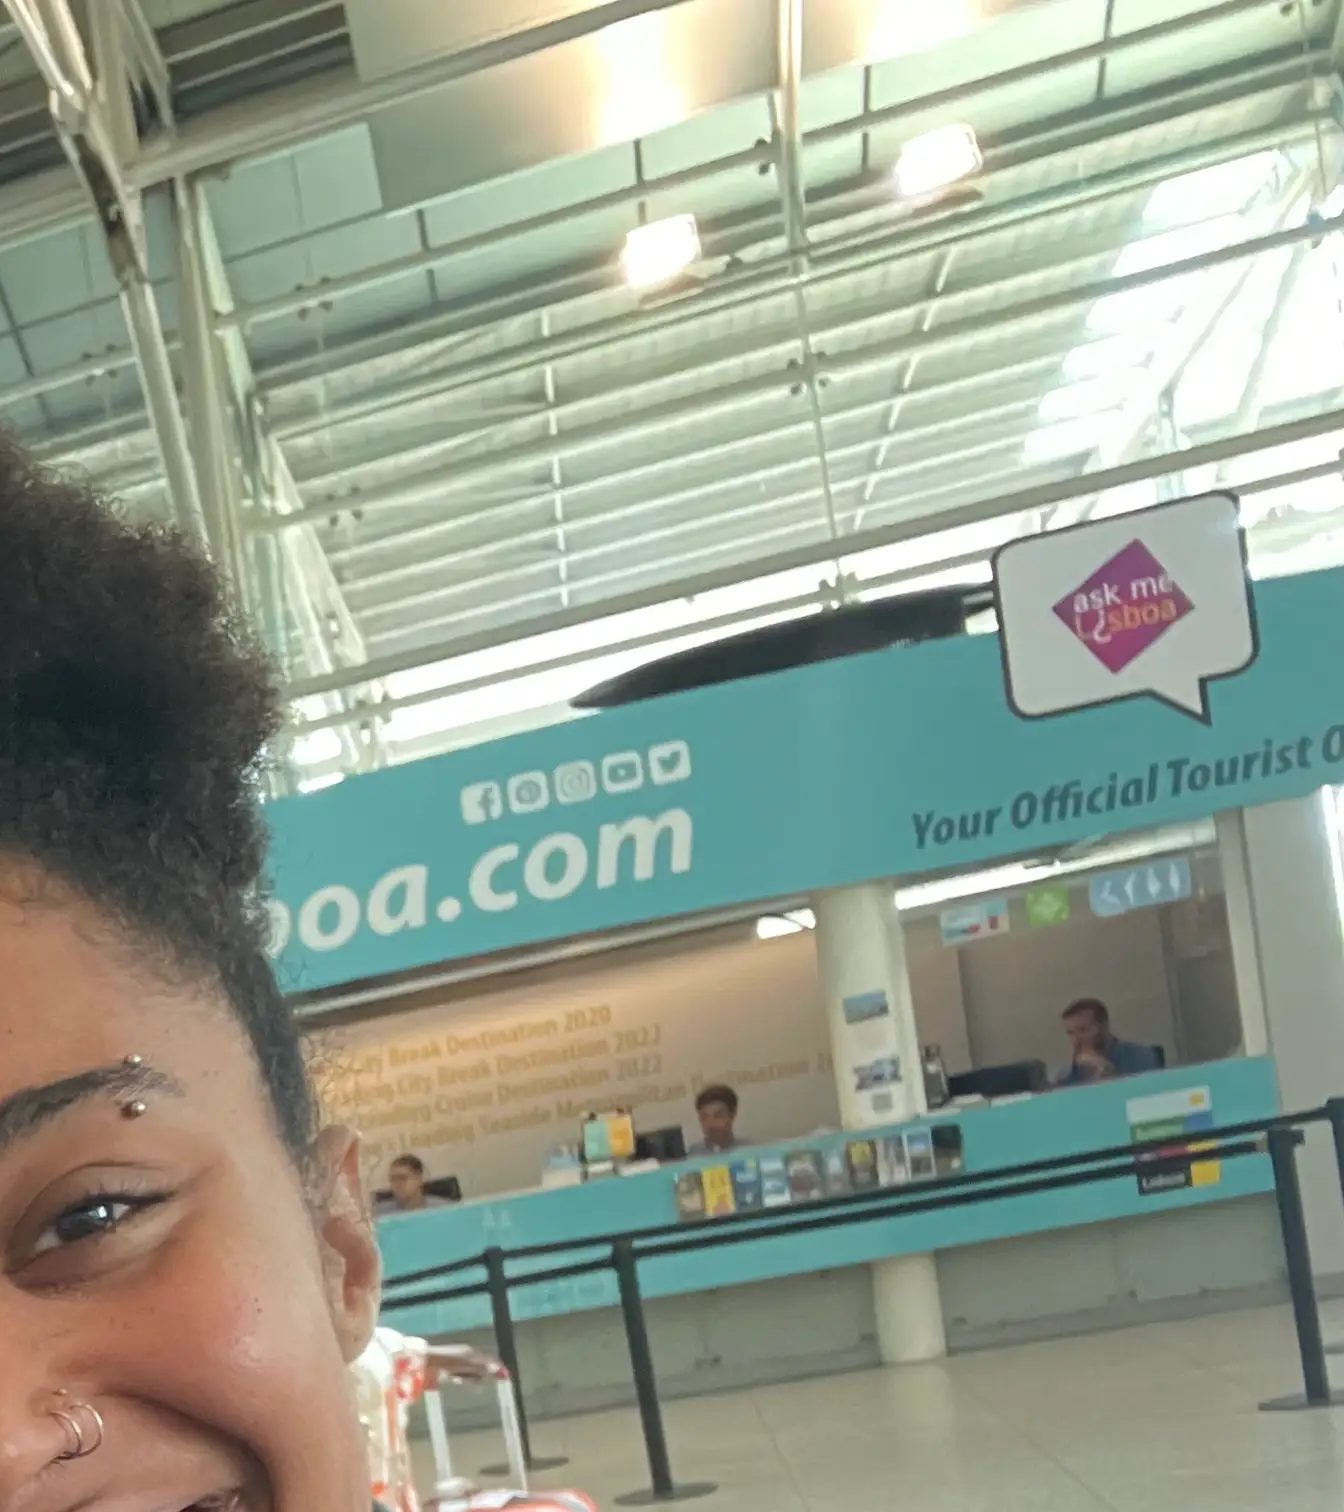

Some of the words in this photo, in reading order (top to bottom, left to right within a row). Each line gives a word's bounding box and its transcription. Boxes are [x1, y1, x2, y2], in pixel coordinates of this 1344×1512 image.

[1073, 583, 1122, 614] ask
[913, 805, 1004, 850] Your
[1012, 763, 1160, 828] Official
[1167, 737, 1314, 797] Tourist
